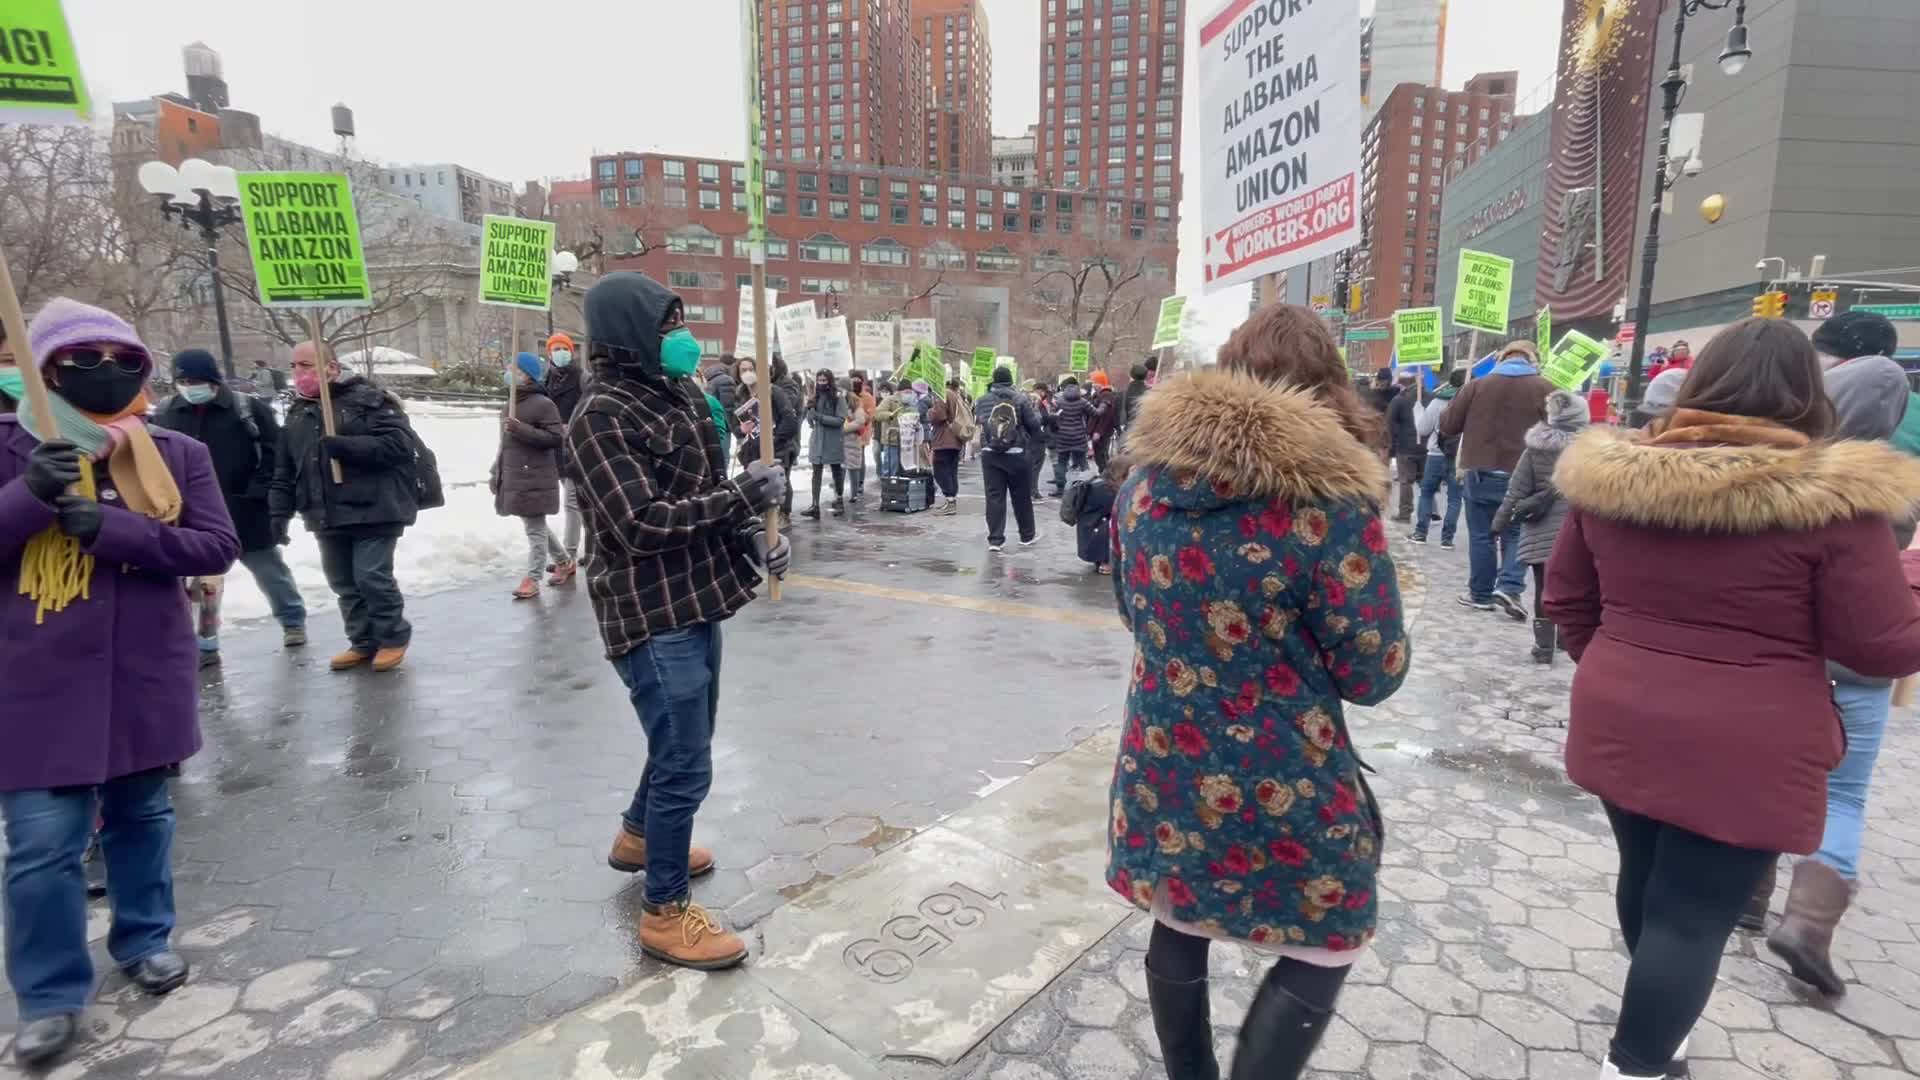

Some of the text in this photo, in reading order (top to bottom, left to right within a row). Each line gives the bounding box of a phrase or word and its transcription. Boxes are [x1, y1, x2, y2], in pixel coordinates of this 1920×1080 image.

[1245, 34, 1285, 78] THE
[1223, 54, 1318, 134] ALABAMA
[1225, 100, 1321, 179] AMAZON
[248, 182, 338, 208] SUPPORT
[1236, 152, 1308, 213] UNION
[1232, 177, 1352, 239] WORKERS WORLD PARTY
[254, 211, 349, 236] ALABAMA
[490, 222, 548, 245] SUPPORT
[1232, 196, 1351, 263] WORKERS.ORG
[259, 237, 353, 261] AMAZON
[487, 241, 546, 265] ALABAMA
[273, 263, 347, 286] UNON
[487, 258, 546, 280] AMAZON
[493, 275, 538, 295] UNON
[1401, 321, 1434, 334] UNION
[843, 882, 1008, 984] 1859
